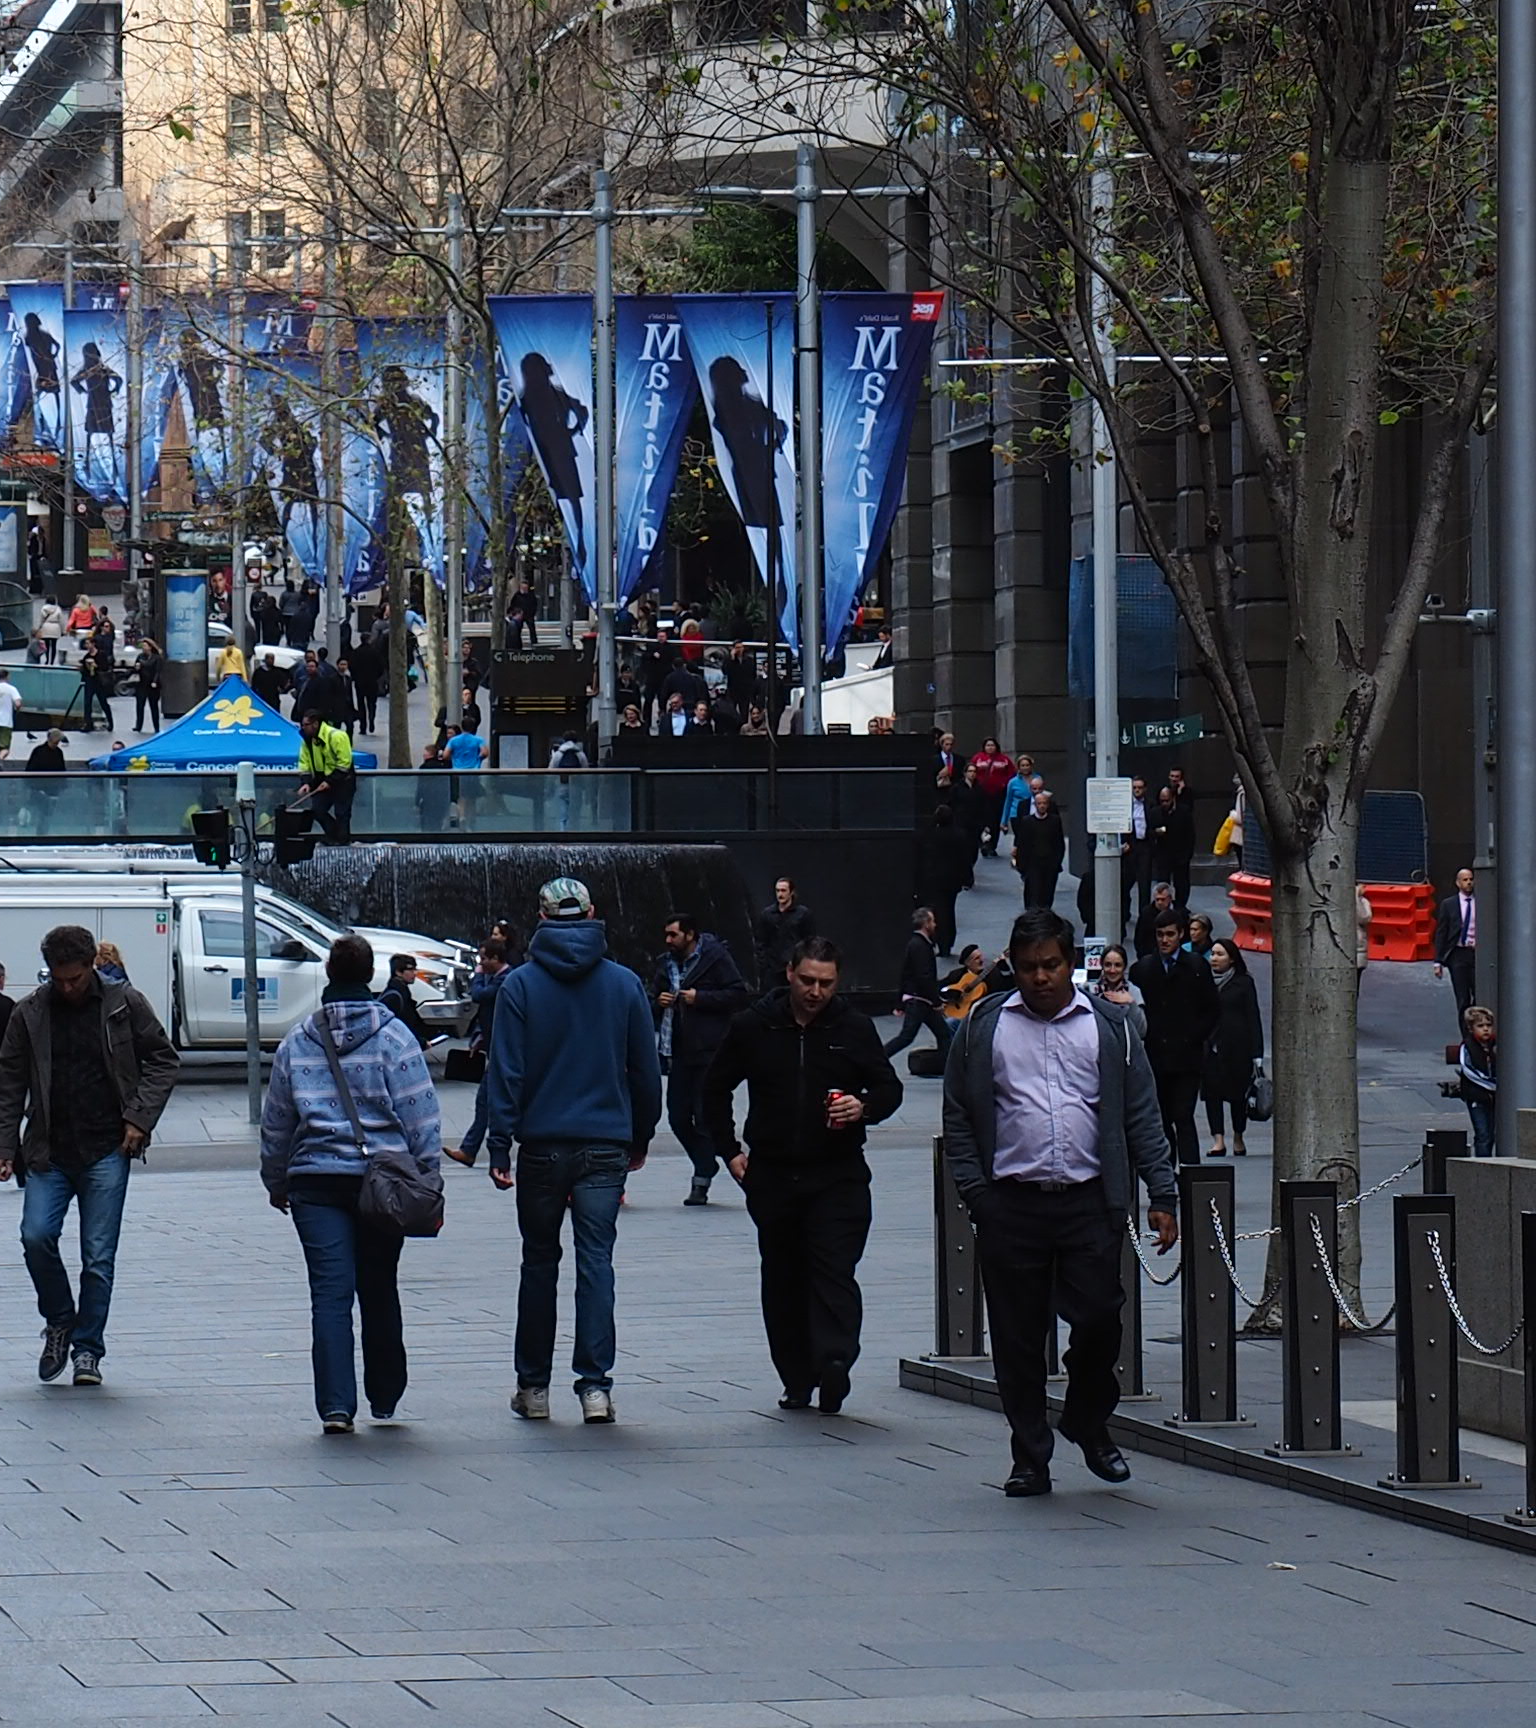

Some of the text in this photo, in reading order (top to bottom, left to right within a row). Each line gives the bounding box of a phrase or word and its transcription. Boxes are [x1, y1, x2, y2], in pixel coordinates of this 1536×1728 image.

[507, 651, 556, 664] Telephone
[1146, 722, 1186, 738] Pitt St
